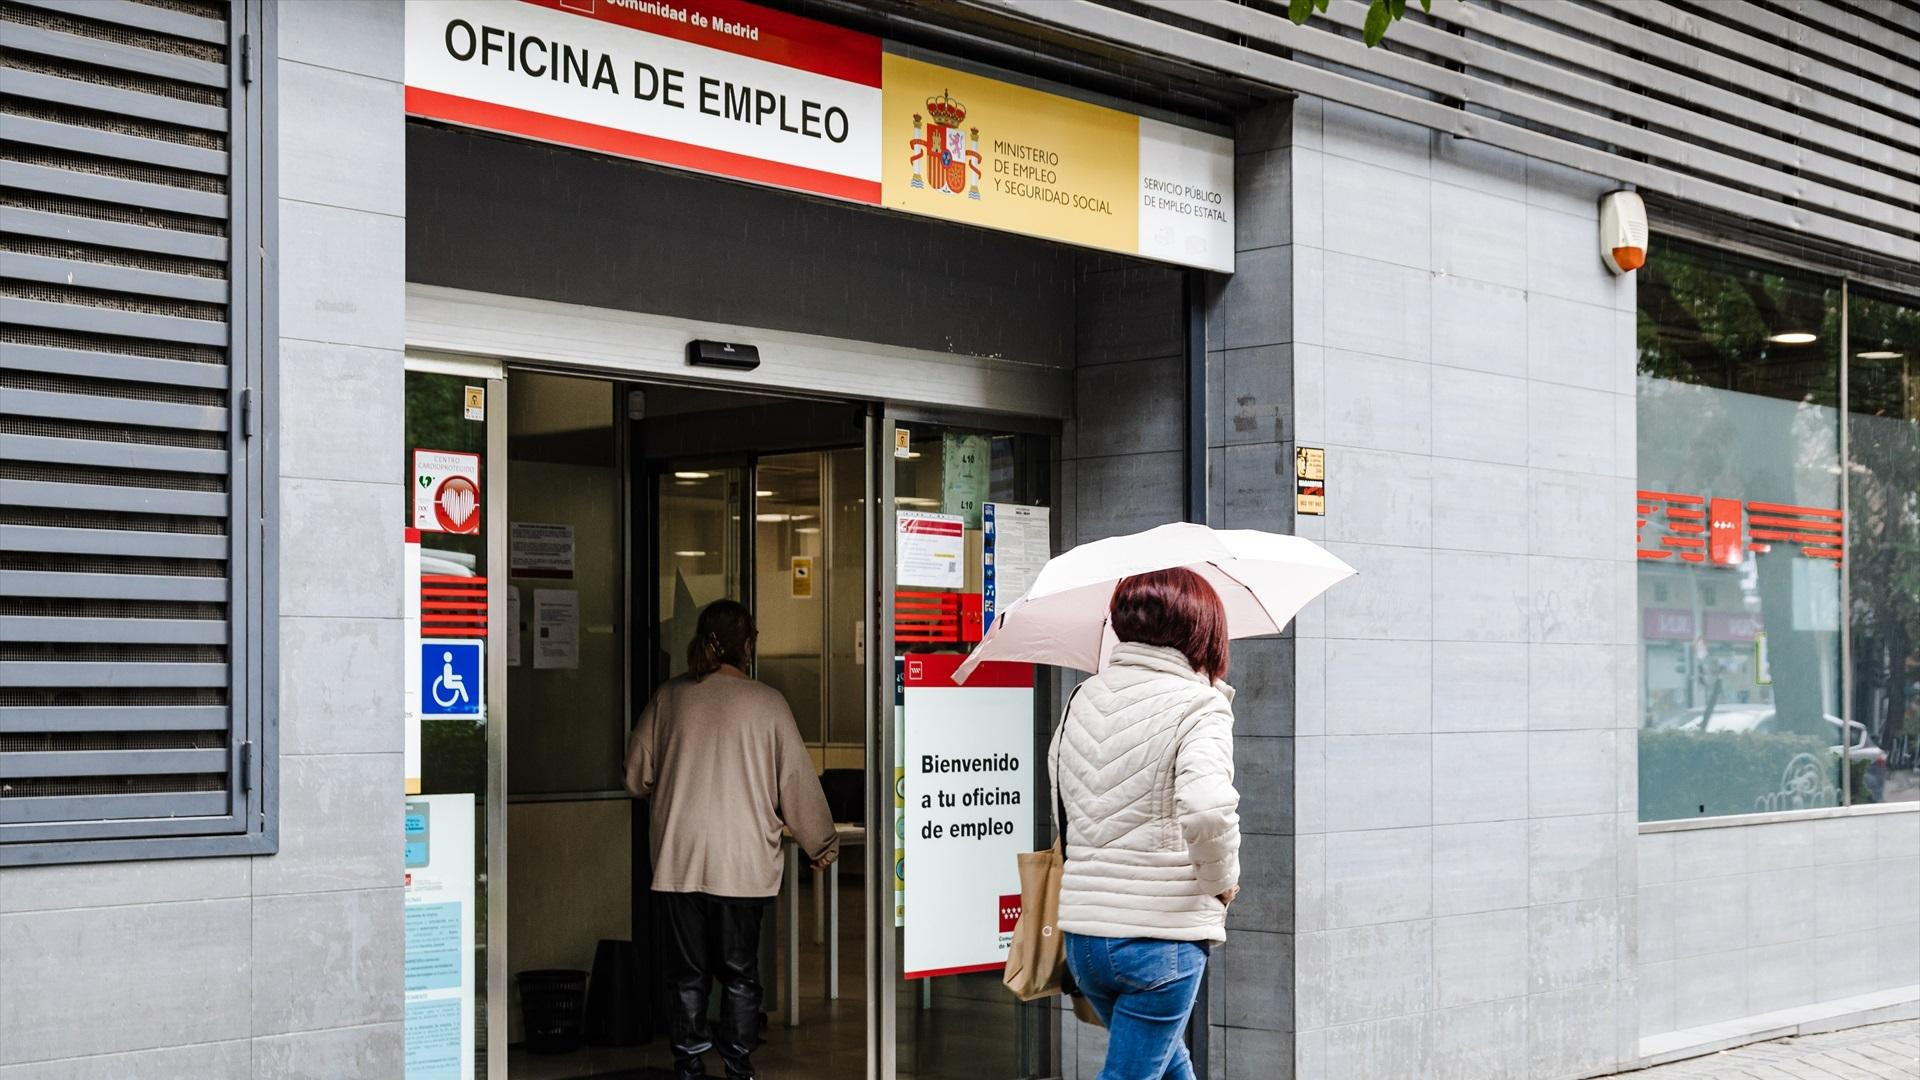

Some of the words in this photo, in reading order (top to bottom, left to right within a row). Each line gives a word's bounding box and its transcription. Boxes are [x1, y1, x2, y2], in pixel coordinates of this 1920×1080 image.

[691, 12, 708, 28] de
[712, 16, 759, 41] Madrid
[444, 18, 619, 95] OFICINA
[633, 61, 685, 109] DE
[699, 75, 850, 143] EMPLEO
[994, 139, 1059, 166] MINISTERIO
[994, 158, 1010, 175] DE
[1013, 162, 1057, 185] EMPLEO
[994, 177, 1001, 192] Y
[1004, 179, 1070, 206] SEGURIDAD
[1072, 194, 1113, 215] SOCIAL
[1143, 177, 1183, 196] SERVICIO
[1184, 185, 1222, 204] PÚBLICO
[1144, 195, 1156, 208] DE
[1158, 198, 1192, 215] EMPLEO
[1194, 205, 1228, 223] ESTATAL
[433, 455, 461, 464] CENTRO
[921, 753, 1020, 774] Bienvenido
[921, 794, 931, 809] a
[938, 790, 956, 808] tu
[962, 786, 1021, 807] oficina
[921, 820, 943, 839] de
[949, 817, 1014, 841] empleo
